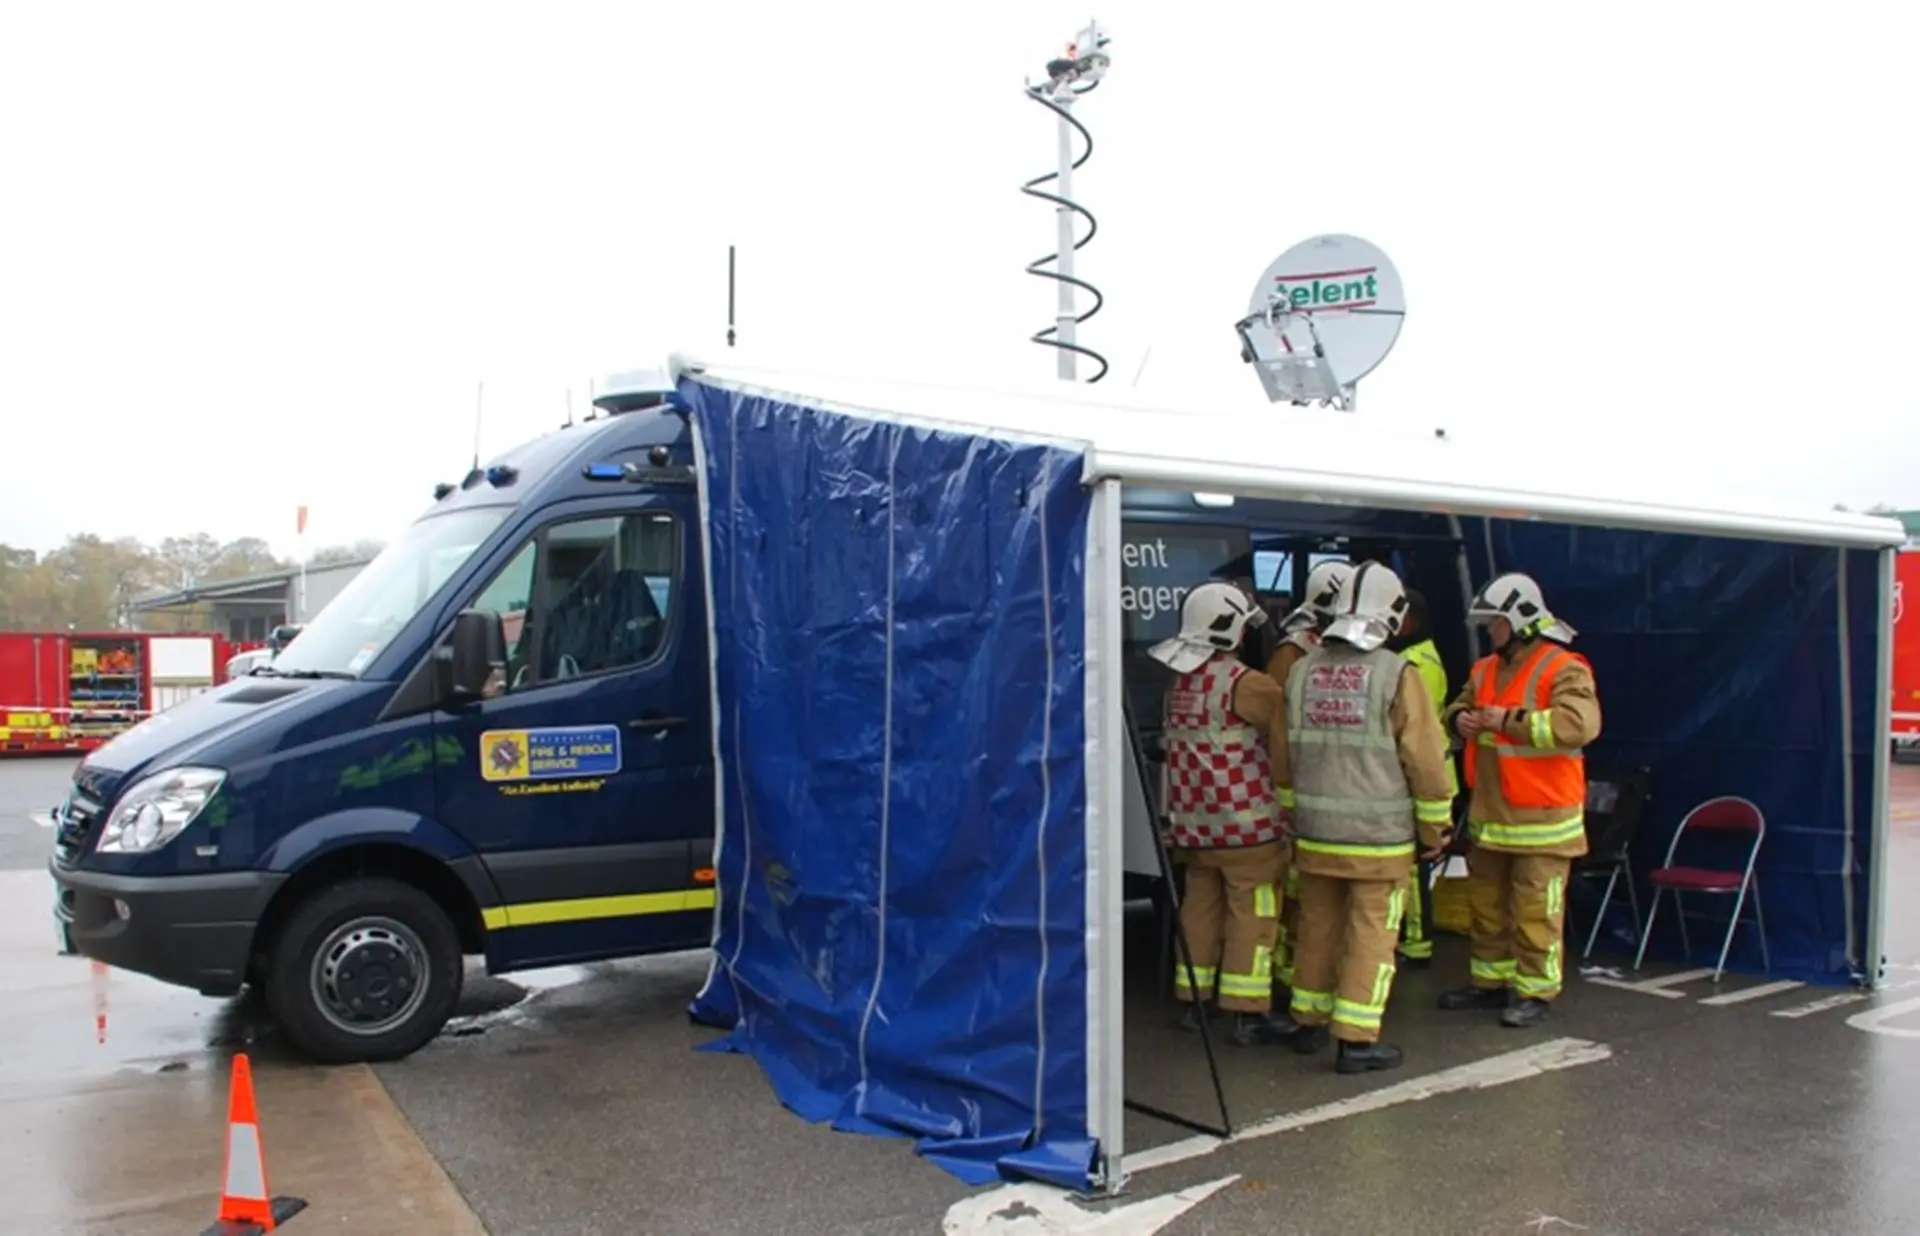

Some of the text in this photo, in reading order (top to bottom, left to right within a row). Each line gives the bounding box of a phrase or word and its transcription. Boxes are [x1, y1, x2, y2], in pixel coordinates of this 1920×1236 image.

[531, 743, 613, 758] FIRE & RESCUE
[532, 758, 578, 770] SERVICE
